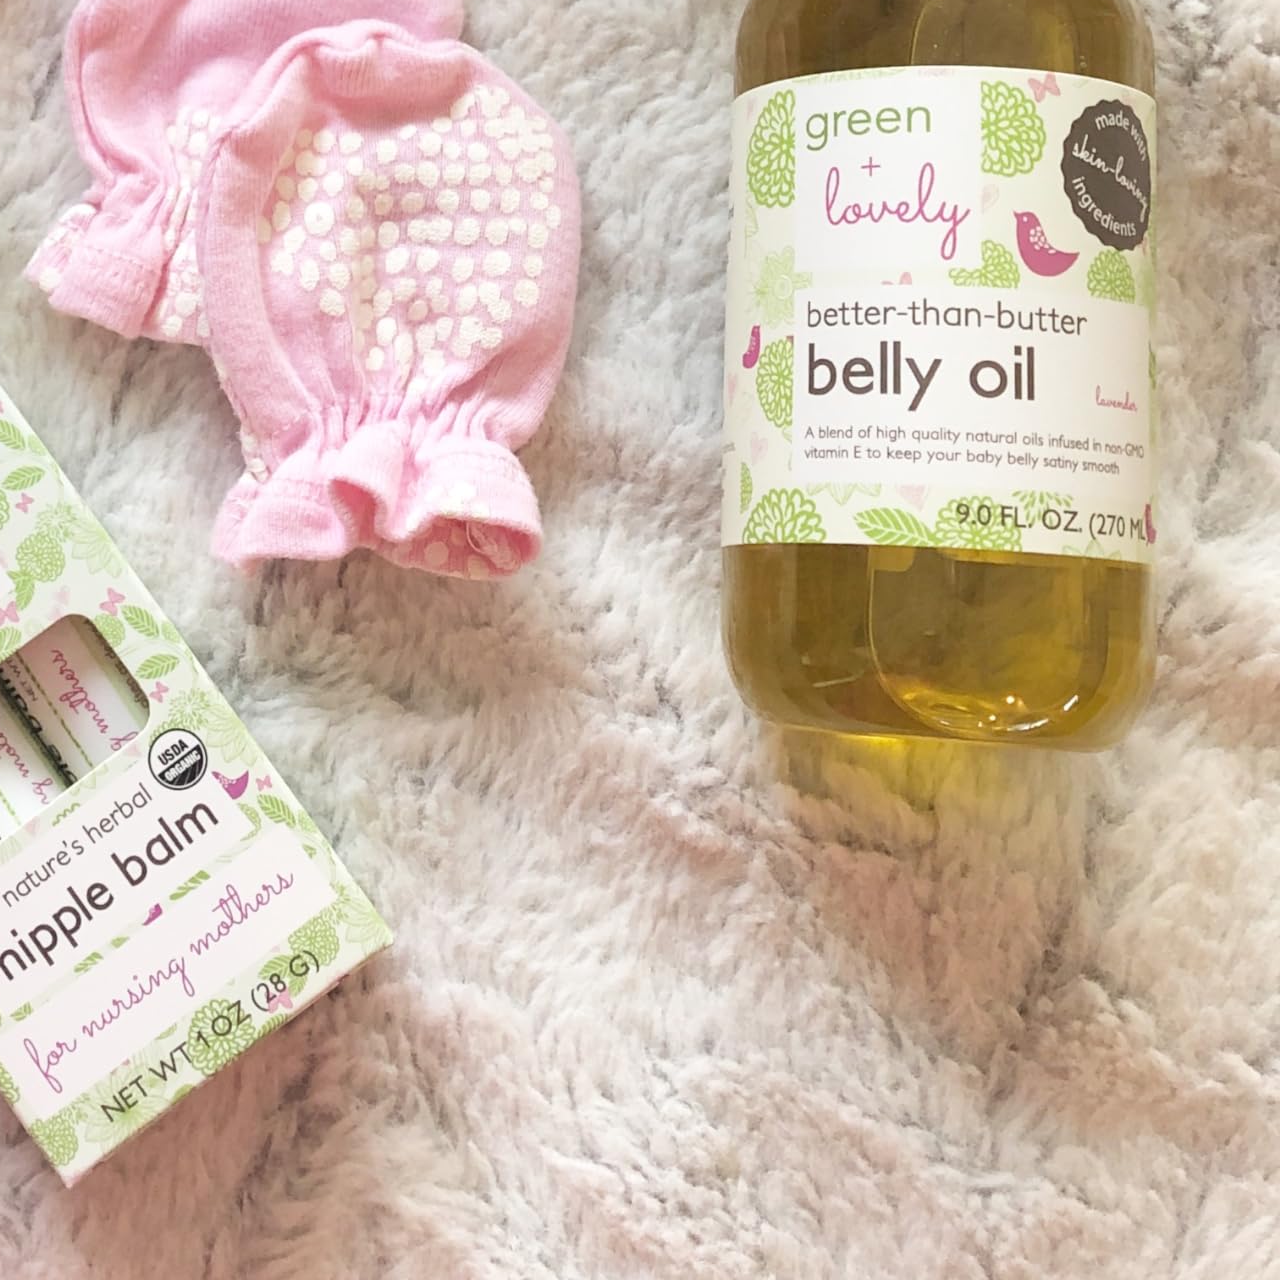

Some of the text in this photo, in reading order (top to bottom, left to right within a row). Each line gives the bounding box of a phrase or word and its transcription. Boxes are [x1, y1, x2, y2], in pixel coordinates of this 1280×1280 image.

[805, 105, 932, 151] green
[1095, 110, 1147, 162] made with
[825, 162, 970, 261] lovely
[1072, 176, 1137, 237] ingredients
[807, 297, 1087, 335] better-than-butter
[807, 341, 1035, 412] belly oil
[1095, 385, 1138, 412] lavender
[804, 425, 1144, 459] A blend of high quality natural oils infused in non-GMO
[804, 446, 1121, 475] vitamin E to keep your baby belly satiny smooth
[955, 504, 991, 526] 9.0
[1001, 506, 1032, 528] FL.
[1041, 508, 1083, 533] OZ.
[1089, 513, 1126, 540] (270
[51, 649, 110, 734] mothers
[157, 738, 189, 766] USDA
[164, 750, 201, 782] ORGANIC
[1, 782, 153, 908] nature's herbal
[110, 802, 219, 887] balm
[23, 873, 294, 1094] for nursing mothers
[100, 950, 320, 1122] NET WT 1 OZ (28 G)
